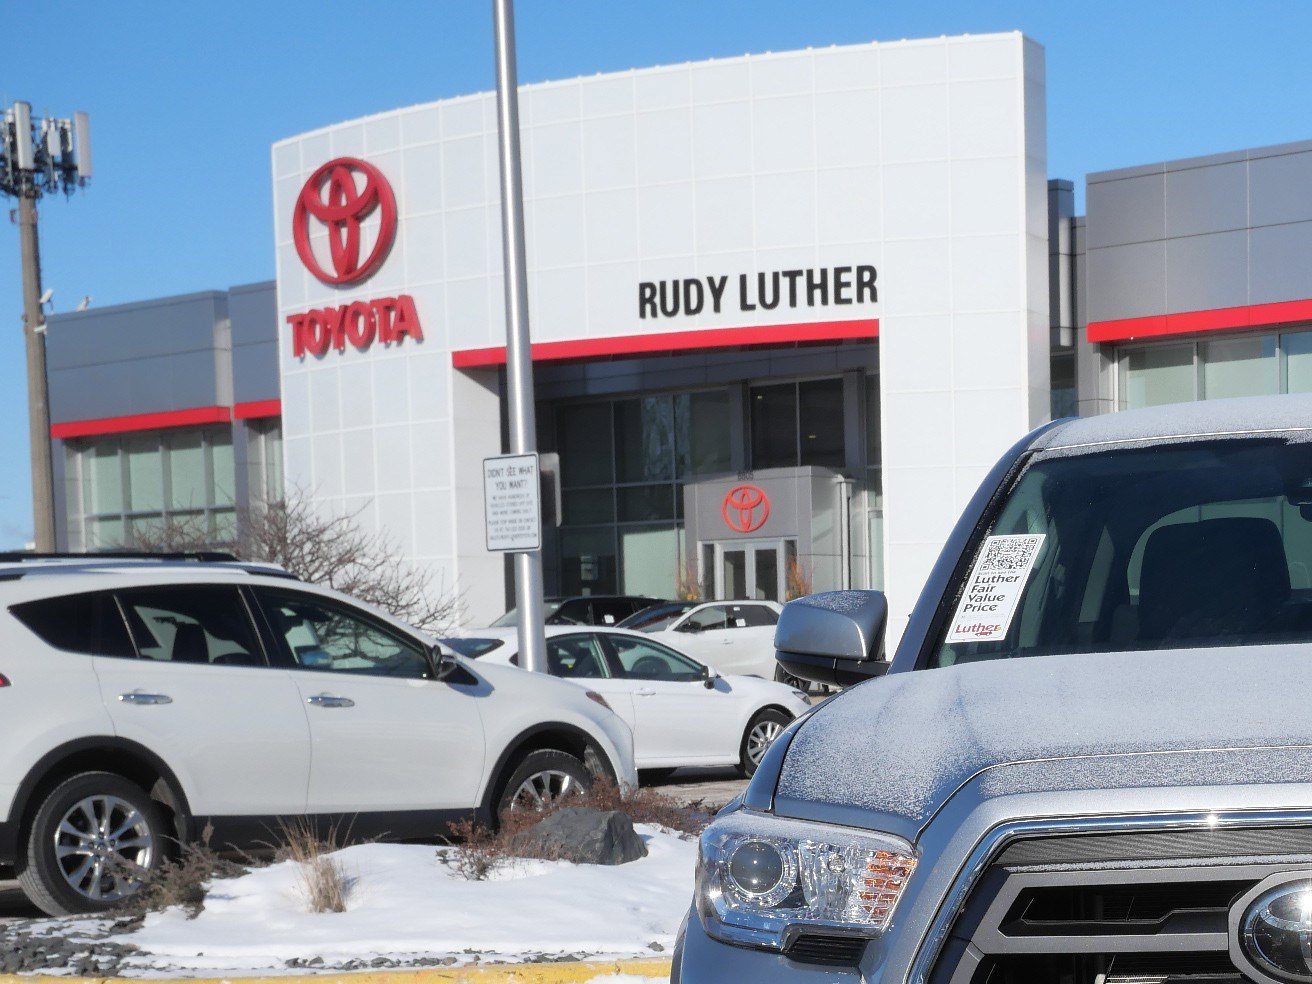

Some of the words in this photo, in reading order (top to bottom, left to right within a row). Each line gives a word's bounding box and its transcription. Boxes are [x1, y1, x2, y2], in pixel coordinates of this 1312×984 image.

[638, 275, 728, 319] RUDY
[739, 265, 878, 312] LUTHER
[286, 294, 424, 359] TOYOTA
[519, 466, 534, 475] WHAT
[496, 481, 507, 490] YOU
[975, 575, 1021, 584] Luther
[970, 583, 997, 593] Fair
[968, 593, 1006, 603] Value
[963, 602, 998, 613] Price
[955, 623, 1000, 633] Luther
